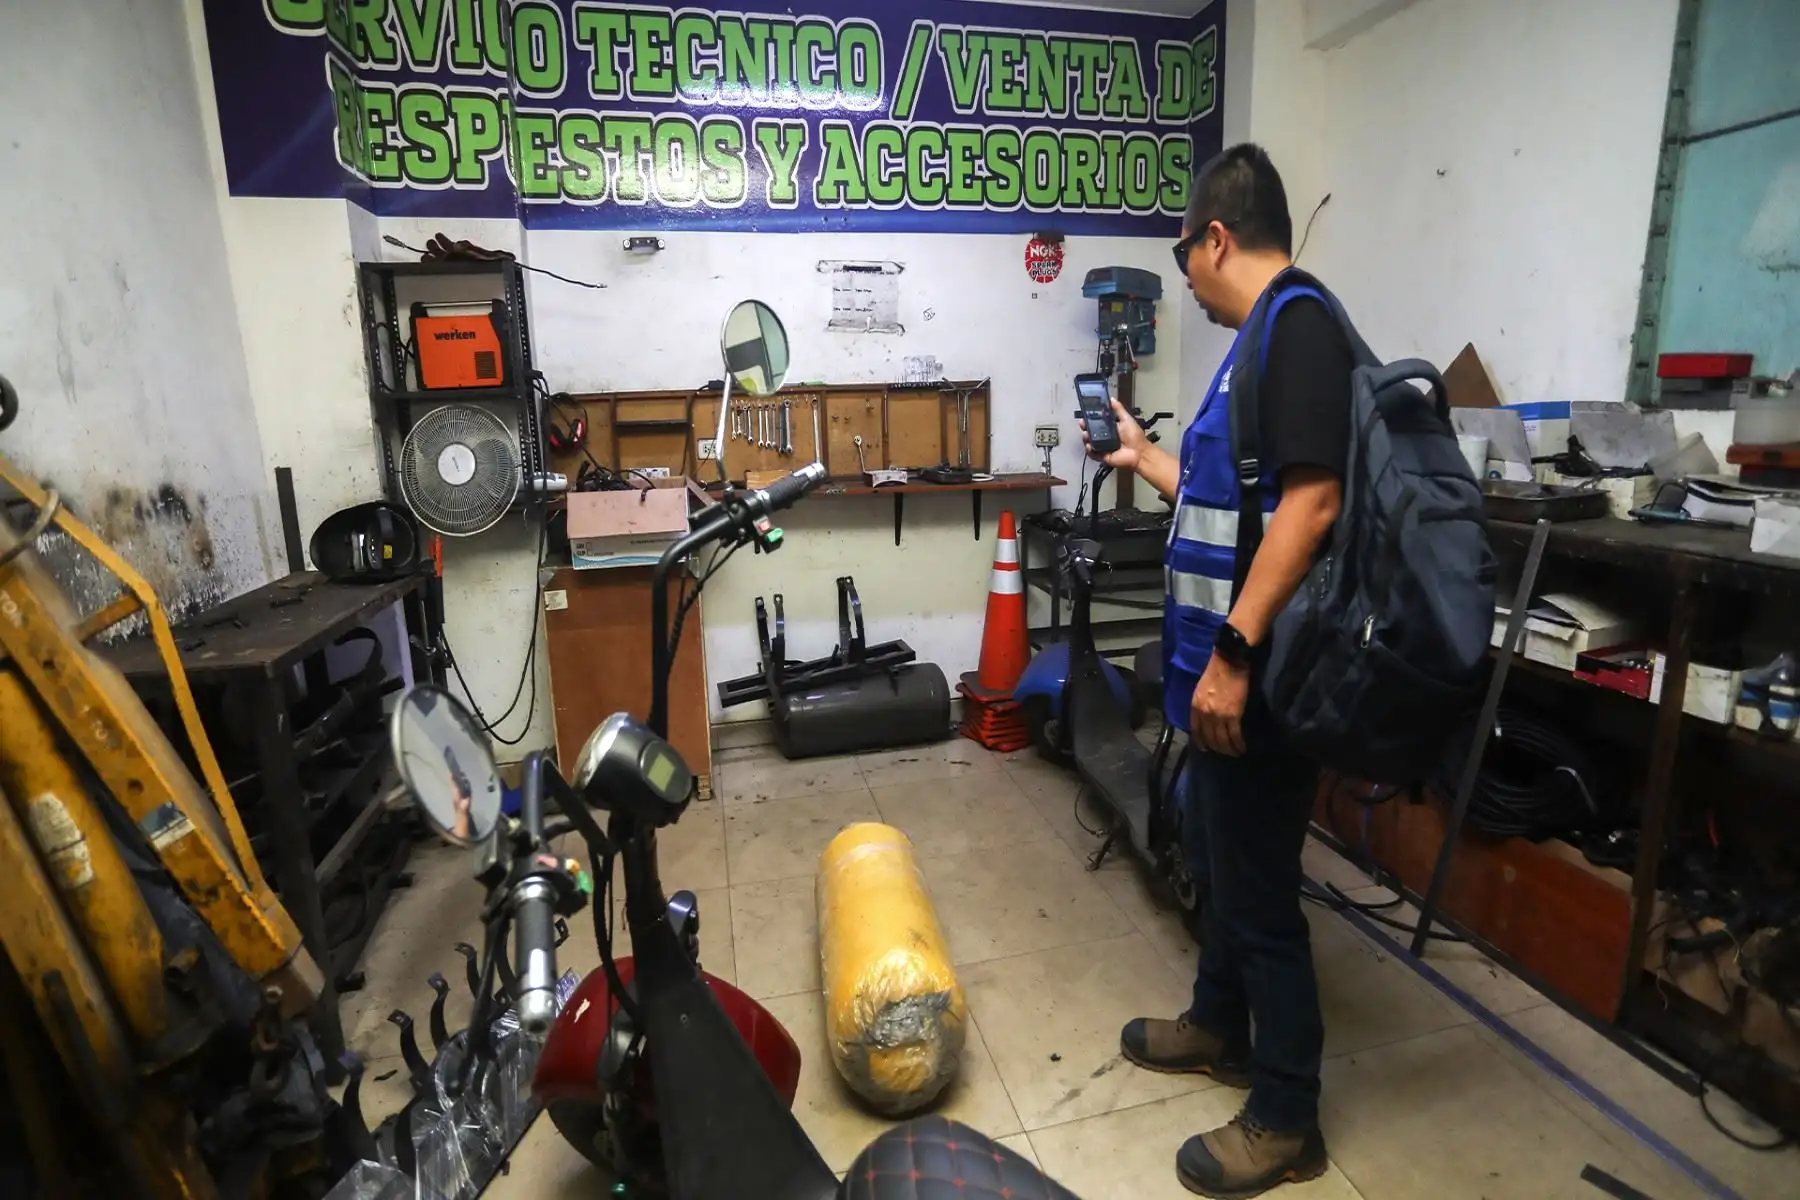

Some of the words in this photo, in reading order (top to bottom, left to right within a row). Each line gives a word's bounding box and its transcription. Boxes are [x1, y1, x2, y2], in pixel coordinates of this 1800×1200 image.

[573, 2, 883, 111] TECNICO
[937, 24, 1150, 123] VENTA
[1154, 26, 1217, 125] DE
[753, 118, 808, 209] Y
[813, 120, 1194, 217] ACCESORIOS
[433, 329, 477, 341] werken
